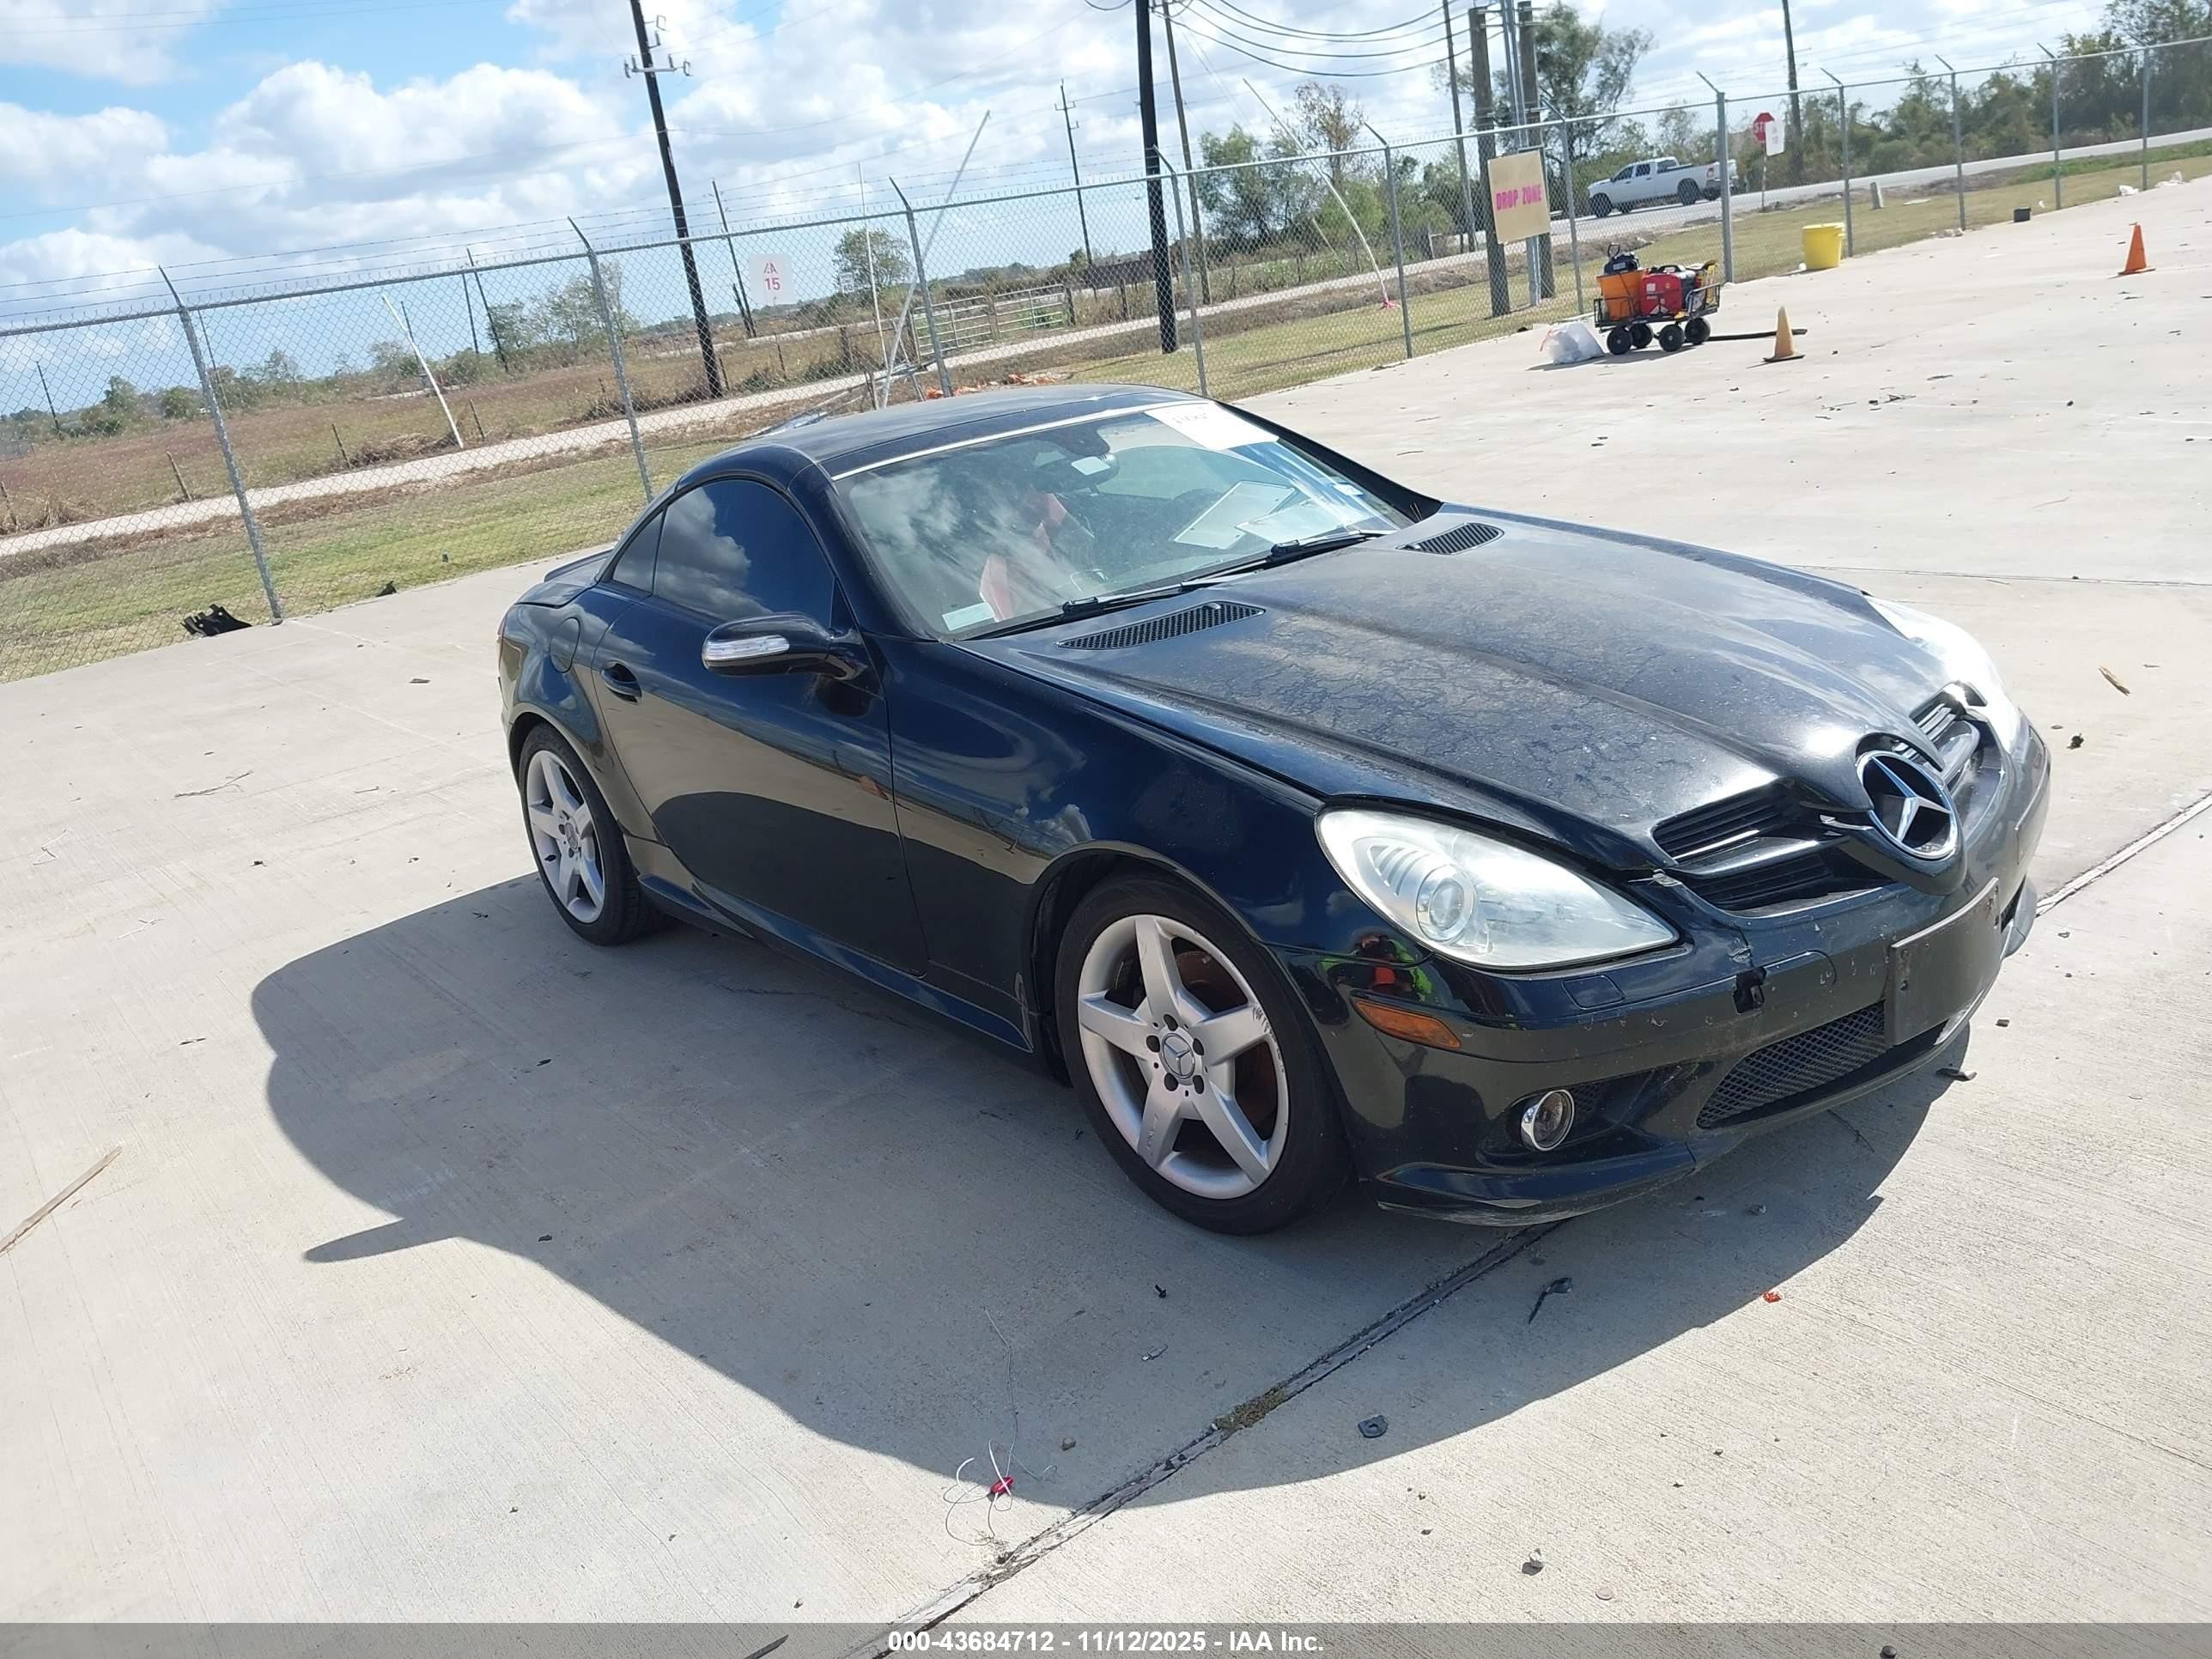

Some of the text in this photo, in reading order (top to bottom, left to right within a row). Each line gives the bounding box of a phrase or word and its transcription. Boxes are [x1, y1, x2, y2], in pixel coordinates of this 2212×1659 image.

[1497, 185, 1541, 210] DROP ZONE
[764, 277, 781, 290] 15
